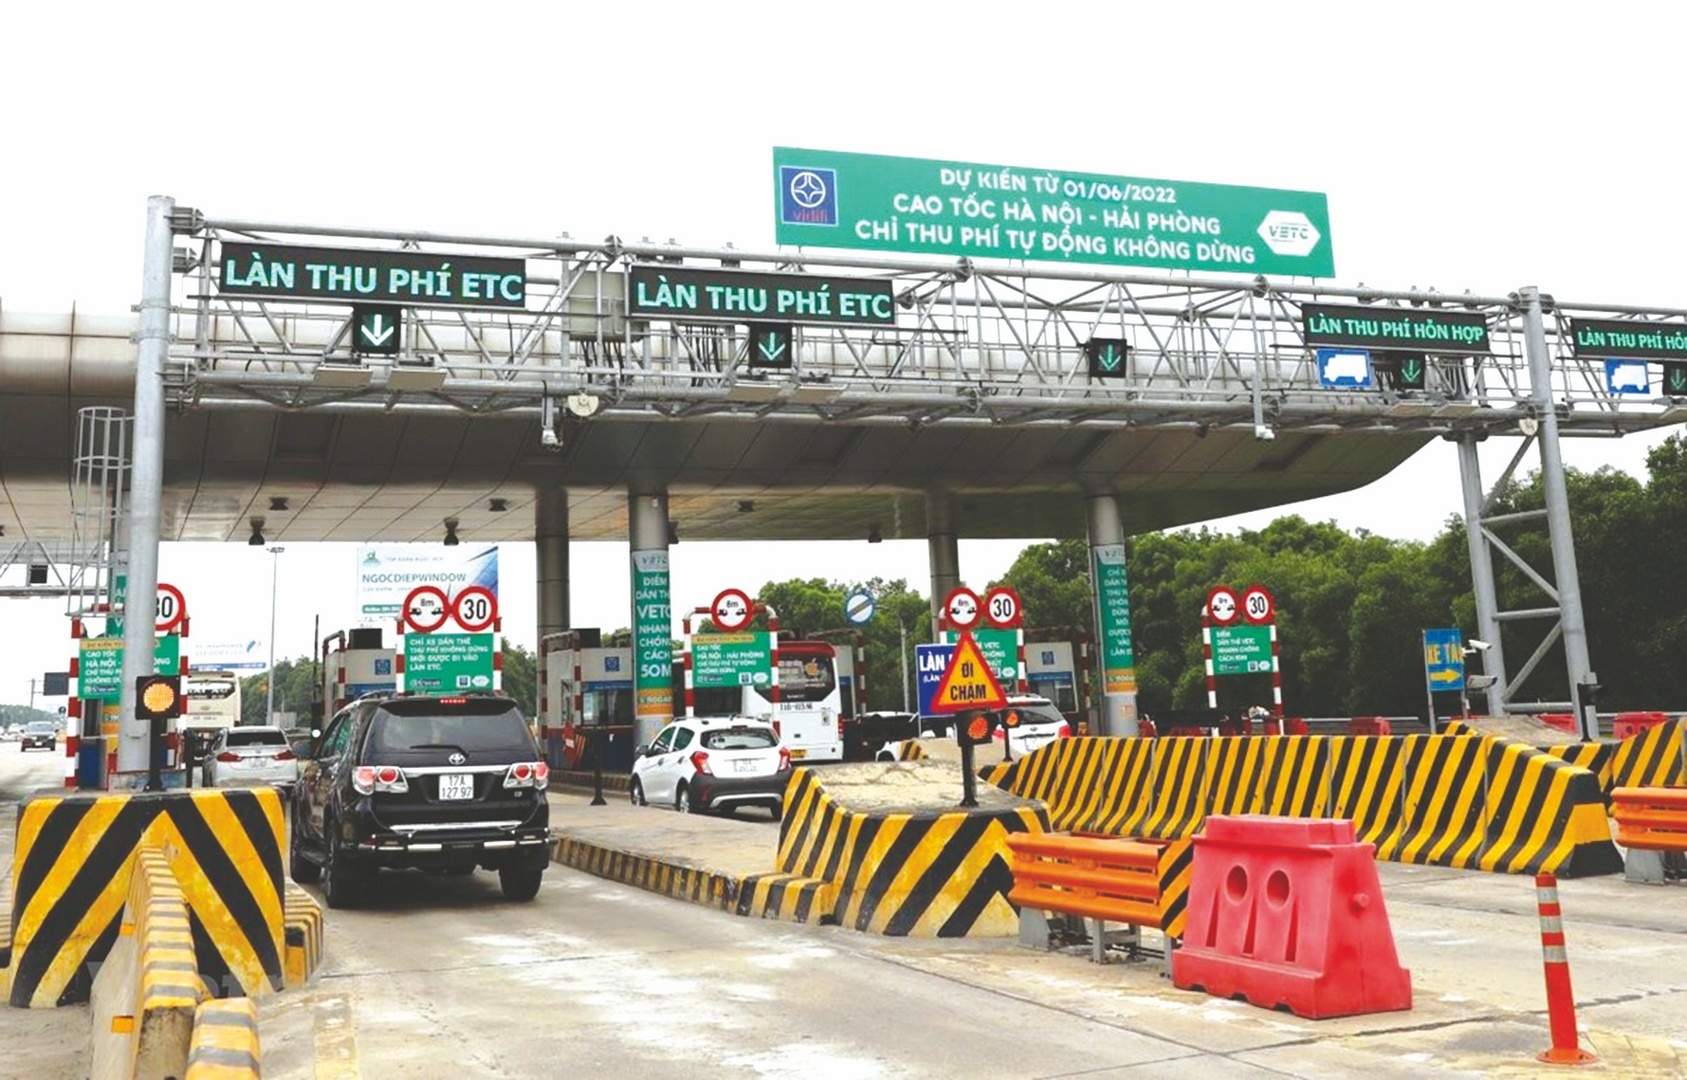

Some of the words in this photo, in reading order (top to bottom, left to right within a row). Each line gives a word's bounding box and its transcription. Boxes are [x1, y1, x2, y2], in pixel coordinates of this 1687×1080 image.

[941, 167, 971, 190] DỰ
[977, 166, 1027, 192] KIẾN
[1033, 171, 1060, 193] TỪ
[1064, 180, 1176, 204] 01/06/2022
[894, 193, 944, 215] CAO
[950, 190, 996, 218] TỐC
[1003, 198, 1036, 223] HÀ
[1042, 201, 1082, 228] NỘI
[1104, 205, 1140, 229] HẢI
[1147, 208, 1220, 236] PHÒNG
[855, 215, 900, 242] CHỈ
[906, 221, 954, 245] THU
[961, 221, 1000, 248] PHÍ
[1007, 225, 1035, 252] TỰ
[1042, 224, 1106, 257] ĐỘNG
[1113, 229, 1190, 260] KHÔNG
[1197, 236, 1254, 265] DỪNG
[1268, 224, 1309, 240] VETC
[226, 252, 294, 289] LÀN
[305, 263, 377, 293] THU
[389, 263, 451, 297] PHÍ
[462, 272, 522, 300] ETC
[638, 275, 697, 308] LÀN
[705, 285, 767, 313] THU
[778, 284, 830, 315] PHÍ
[839, 293, 891, 318] ETC
[1309, 313, 1342, 334] LÀN
[1345, 318, 1378, 337] THU
[1382, 315, 1411, 339] PHÍ
[1414, 317, 1449, 341] HỖN
[1452, 325, 1483, 346] HỢP
[1578, 326, 1605, 346] LÀN
[1607, 332, 1636, 348] THU
[1638, 330, 1662, 349] PHÍ
[362, 573, 467, 583] NGOCDIEPWINDOW
[636, 588, 657, 600] DÁN
[659, 589, 671, 599] TH
[464, 598, 487, 620] 30
[993, 598, 1012, 618] 30
[1249, 596, 1266, 615] 30
[409, 662, 425, 671] LÀN
[919, 651, 946, 672] LÀN
[961, 662, 974, 678] ĐI
[449, 775, 466, 786] 17A
